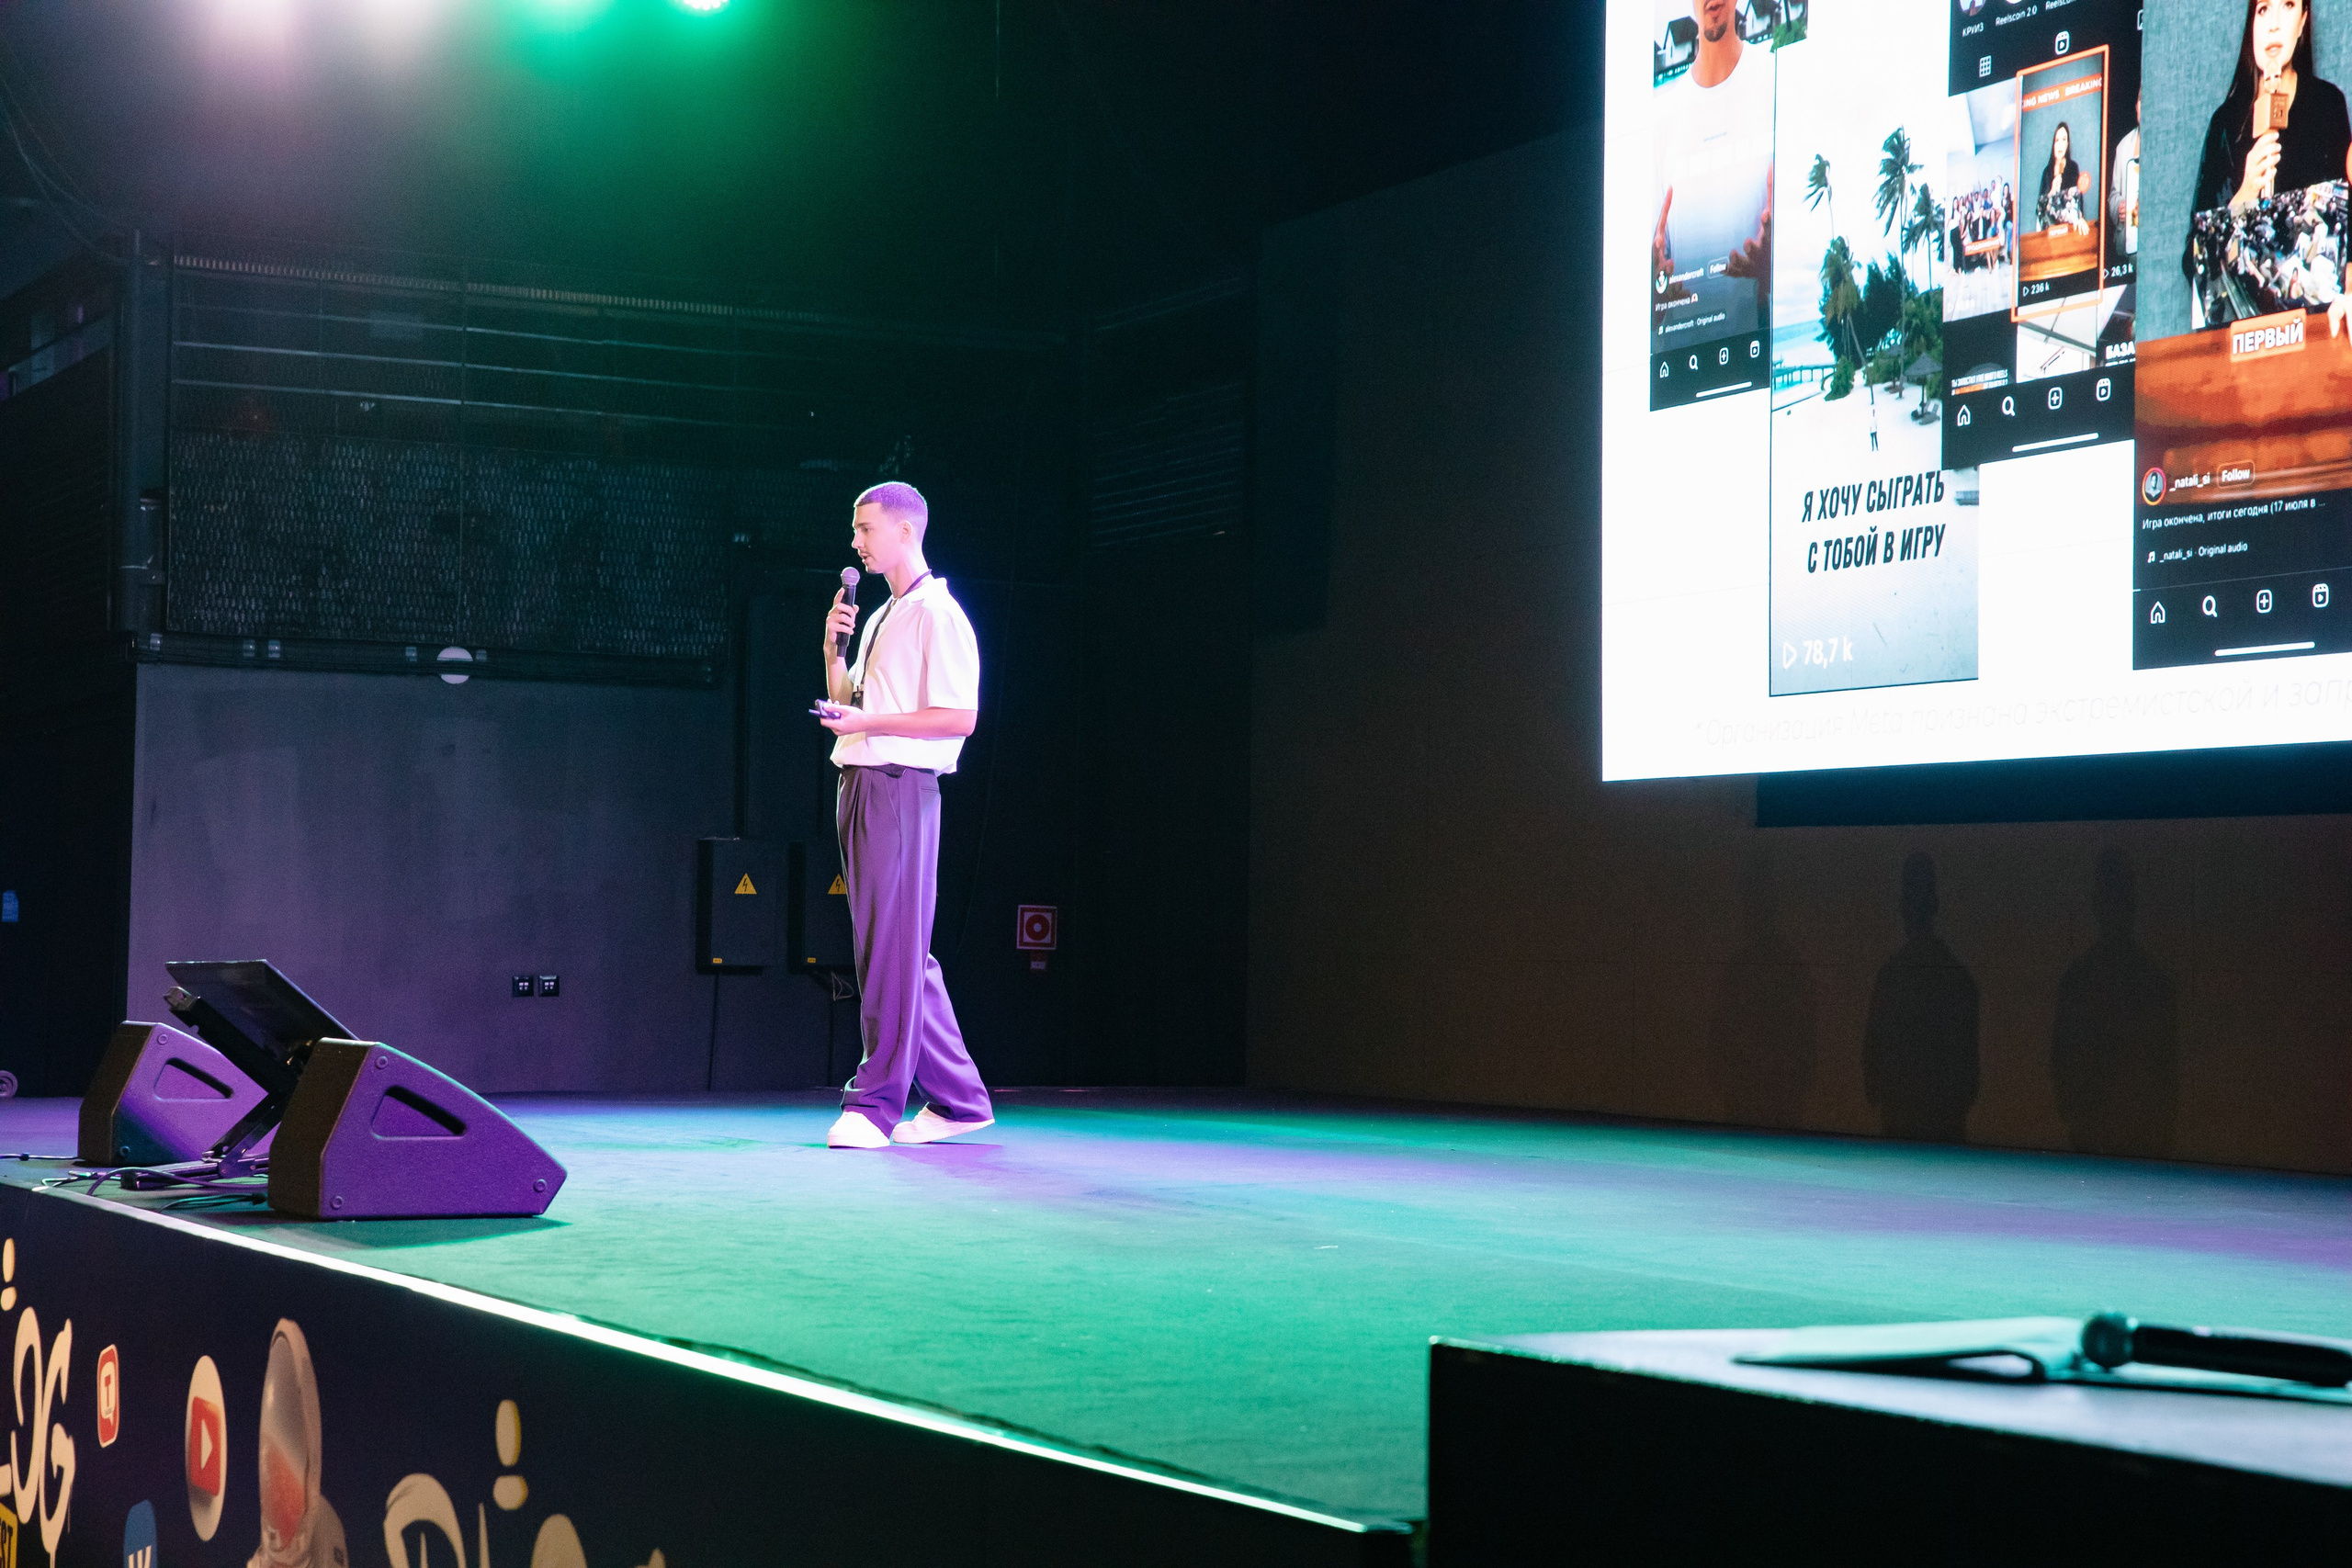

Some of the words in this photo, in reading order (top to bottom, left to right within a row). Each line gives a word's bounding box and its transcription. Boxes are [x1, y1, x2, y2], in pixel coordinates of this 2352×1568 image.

[1996, 9, 2025, 26] Reelscoin
[1962, 22, 1984, 37] КРУИЗ
[2038, 89, 2060, 104] NEWS
[2111, 265, 2127, 277] 26,3
[2030, 284, 2044, 295] 236
[2233, 317, 2304, 355] ПЕРВЫЙ
[2106, 341, 2136, 359] БАЗА
[2222, 468, 2251, 482] Follow
[1802, 491, 1814, 523] Я
[1817, 483, 1863, 521] ХОЧУ
[1866, 469, 1945, 513] СЫГРАТЬ
[2142, 518, 2163, 530] Игра
[2164, 513, 2206, 527] окончена,
[2207, 509, 2232, 522] итоги
[2233, 505, 2268, 519] сегодня
[2270, 501, 2283, 515] (17
[2284, 500, 2308, 512] июля
[1807, 541, 1818, 573] С
[1824, 525, 1878, 571] ТОБОЙ
[1883, 531, 1894, 563] В
[1900, 524, 1946, 561] ИГРУ
[2198, 544, 2226, 558] Original
[2227, 541, 2248, 553] audio
[1803, 637, 1838, 669] 78,7
[1849, 708, 1903, 736] Meta
[1910, 702, 2028, 738] признана
[2036, 680, 2254, 729] экстремистской
